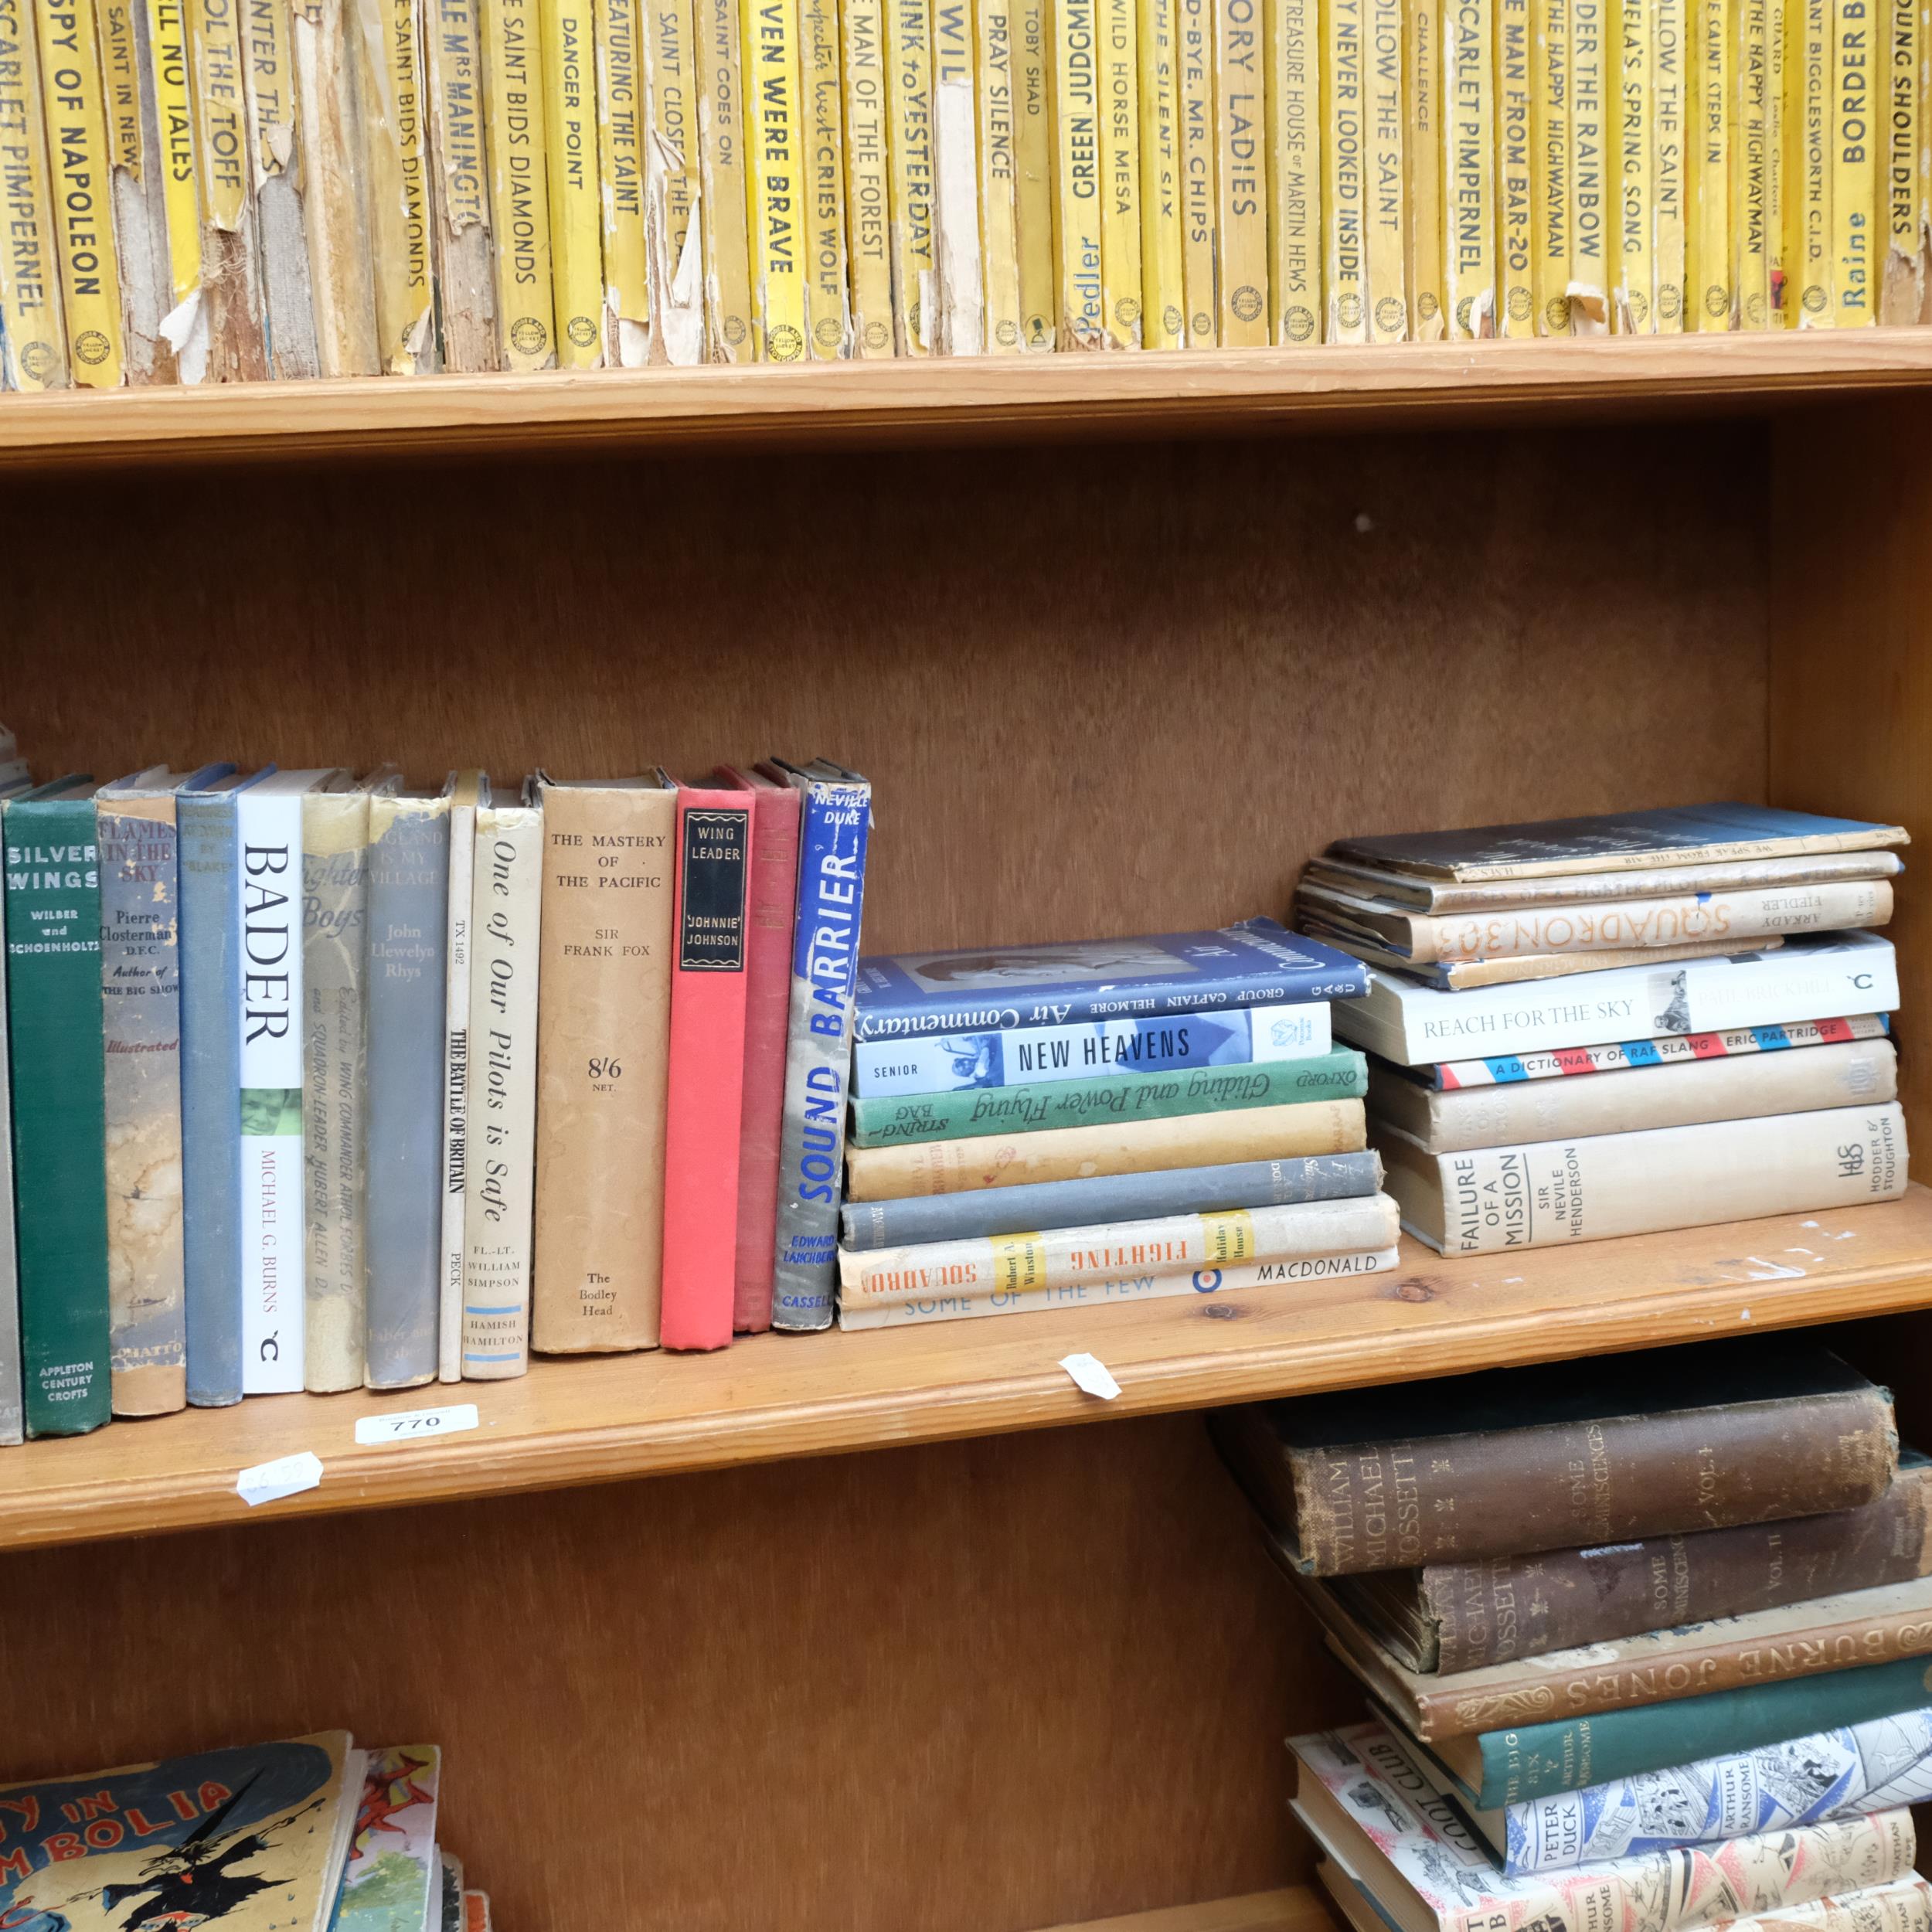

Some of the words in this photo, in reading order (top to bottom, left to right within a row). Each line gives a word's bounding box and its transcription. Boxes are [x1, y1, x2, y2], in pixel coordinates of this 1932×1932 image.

[108, 7, 130, 74] SAINT
[504, 18, 526, 84] SAINT
[853, 15, 876, 67] MAN
[988, 15, 1008, 73] PRAY
[1026, 8, 1039, 56] TOBY
[1506, 25, 1525, 79] MAN
[162, 45, 185, 86] NO
[208, 44, 235, 98] THE
[563, 19, 580, 107] DANGER
[1337, 22, 1358, 99] NEVER
[1548, 43, 1564, 111] HAPPY
[54, 69, 83, 110] OF
[855, 79, 877, 110] OF
[1026, 67, 1039, 116] SHAD
[1113, 62, 1128, 138] HORSE
[1158, 62, 1171, 159] SILENT
[1577, 63, 1597, 111] THE
[1842, 30, 1866, 164] BORDER
[507, 92, 529, 145] BIDS
[612, 111, 634, 148] THE
[764, 77, 789, 161] WERE
[990, 86, 1011, 179] SILENCE
[1188, 99, 1204, 148] MR.
[1287, 90, 1304, 151] HOUSE
[1377, 90, 1397, 139] THE
[1507, 91, 1526, 165] FROM
[1624, 83, 1641, 174] SPRING
[1808, 43, 1821, 201] BIGGLESWORTH
[212, 113, 241, 188] TOFF
[566, 121, 583, 189] POINT
[857, 119, 879, 163] THE
[1071, 117, 1095, 199] GREEN
[1230, 94, 1257, 216] LADIES
[1293, 155, 1301, 168] OF
[1338, 109, 1358, 199] LOOKED
[1893, 76, 1913, 235] SHOULDERS
[614, 155, 639, 216] SAINT
[817, 147, 835, 219] CRIES
[904, 91, 931, 259] YESTERDAY
[1114, 150, 1131, 215] MESA
[1161, 170, 1172, 218] SIX
[1189, 157, 1207, 243] CHIPS
[1378, 152, 1398, 230] SAINT
[1458, 123, 1481, 274] PIMPERNEL
[1548, 120, 1564, 257] HIGHWAYMAN
[1577, 123, 1600, 257] RAINBOW
[60, 127, 100, 295] NAPOLEON
[510, 156, 536, 284] DIAMONDS
[767, 176, 793, 273] BRAVE
[859, 175, 883, 260] FOREST
[1287, 171, 1306, 236] MARTIN
[1508, 178, 1528, 270] BAR-20
[1624, 185, 1641, 253] SONG
[2, 145, 43, 317] PIMPERNEL
[1338, 209, 1359, 281] INSIDE
[818, 229, 838, 295] WOLF
[1073, 236, 1101, 334] Pedler
[1288, 243, 1306, 292] HEWS
[1842, 212, 1866, 308] Raine
[552, 835, 583, 846] THE
[592, 836, 665, 847] MASTERY
[699, 827, 734, 840] WING
[825, 811, 861, 825] DUKE
[8, 845, 96, 864] SILVER
[493, 841, 517, 896] One
[598, 857, 619, 867] OF
[692, 848, 740, 860] LEADER
[8, 871, 98, 889] WINGS
[556, 876, 589, 887] THE
[599, 877, 661, 888] PACIFIC
[1762, 896, 1822, 910] FIEDLER
[31, 910, 78, 920] WILBER
[116, 910, 160, 924] Pierre
[386, 924, 421, 940] John
[455, 920, 465, 938] TX
[486, 912, 515, 947] of
[595, 930, 619, 940] SIR
[687, 934, 738, 946] JOHNSON
[245, 842, 289, 1046] BADER
[454, 941, 464, 965] 1492
[564, 945, 613, 956] FRANK
[623, 946, 650, 955] FOX
[810, 854, 857, 1038] BARRIER
[385, 964, 421, 982] Rhys
[490, 958, 514, 1013] Our
[1237, 988, 1284, 1002] GROUP
[859, 1007, 1020, 1038] Commentary
[1029, 1004, 1073, 1026] Air
[1090, 998, 1155, 1014] HELMORE
[1168, 992, 1226, 1007] CAPTAIN
[1424, 1014, 1495, 1039] REACH
[1502, 1009, 1546, 1030] FOR
[1548, 1004, 1591, 1025] THE
[1597, 999, 1634, 1019] SKY
[451, 1029, 467, 1060] THE
[488, 1028, 512, 1110] Pilots
[874, 1065, 917, 1079] SENIOR
[1019, 1040, 1070, 1072] NEW
[1084, 1028, 1189, 1066] HEAVENS
[1511, 1053, 1601, 1074] DICTIONARY
[1607, 1049, 1625, 1062] OF
[1631, 1046, 1657, 1059] RAF
[1662, 1039, 1709, 1055] SLANG
[1726, 1034, 1757, 1048] ERIC
[1762, 1024, 1837, 1043] PARTRIDGE
[450, 1062, 466, 1114] BATTLE
[1055, 1086, 1127, 1113] Power
[1136, 1083, 1179, 1110] and
[1188, 1072, 1270, 1102] Gliding
[1297, 1070, 1358, 1088] OXFORD
[450, 1117, 465, 1136] OF
[970, 1088, 1052, 1122] Flying
[487, 1125, 509, 1145] is
[799, 1066, 842, 1203] SOUND
[1881, 1117, 1896, 1191] STOUGHTON
[261, 1151, 277, 1229] MICHAEL
[449, 1138, 465, 1193] BRITAIN
[1483, 1180, 1498, 1194] A
[1870, 1138, 1882, 1192] HODDER
[480, 1159, 508, 1223] Safe
[1455, 1158, 1479, 1251] FAILURE
[1485, 1200, 1500, 1226] OF
[1499, 1153, 1524, 1246] MISSION
[1553, 1169, 1566, 1221] NEVILE
[1565, 1147, 1582, 1237] HENDERSON
[262, 1234, 277, 1250] G.
[468, 1261, 520, 1270] WILLIAM
[262, 1257, 277, 1314] BURNS
[451, 1253, 461, 1286] PECK
[468, 1277, 519, 1287] SIMPSON
[587, 1274, 610, 1284] The
[1257, 1255, 1377, 1282] MACDONALD
[580, 1290, 617, 1301] Bodley
[583, 1306, 612, 1316] Head
[471, 1320, 516, 1329] HAMISH
[39, 1362, 94, 1376] APPLETON
[42, 1374, 93, 1389] CENTURY
[48, 1388, 88, 1402] CROFTS
[390, 1417, 440, 1431] 770
[1359, 1447, 1386, 1566] MICHAEL
[1738, 1628, 1886, 1679] BURNE
[1566, 1658, 1716, 1708] JONES
[1369, 1743, 1425, 1791] CLUB
[60, 1790, 119, 1824] IN
[1726, 1767, 1734, 1830] ARTHUR
[1739, 1760, 1753, 1829] RANSOME
[1544, 1802, 1558, 1861] PETER
[1563, 1804, 1577, 1855] DUCK
